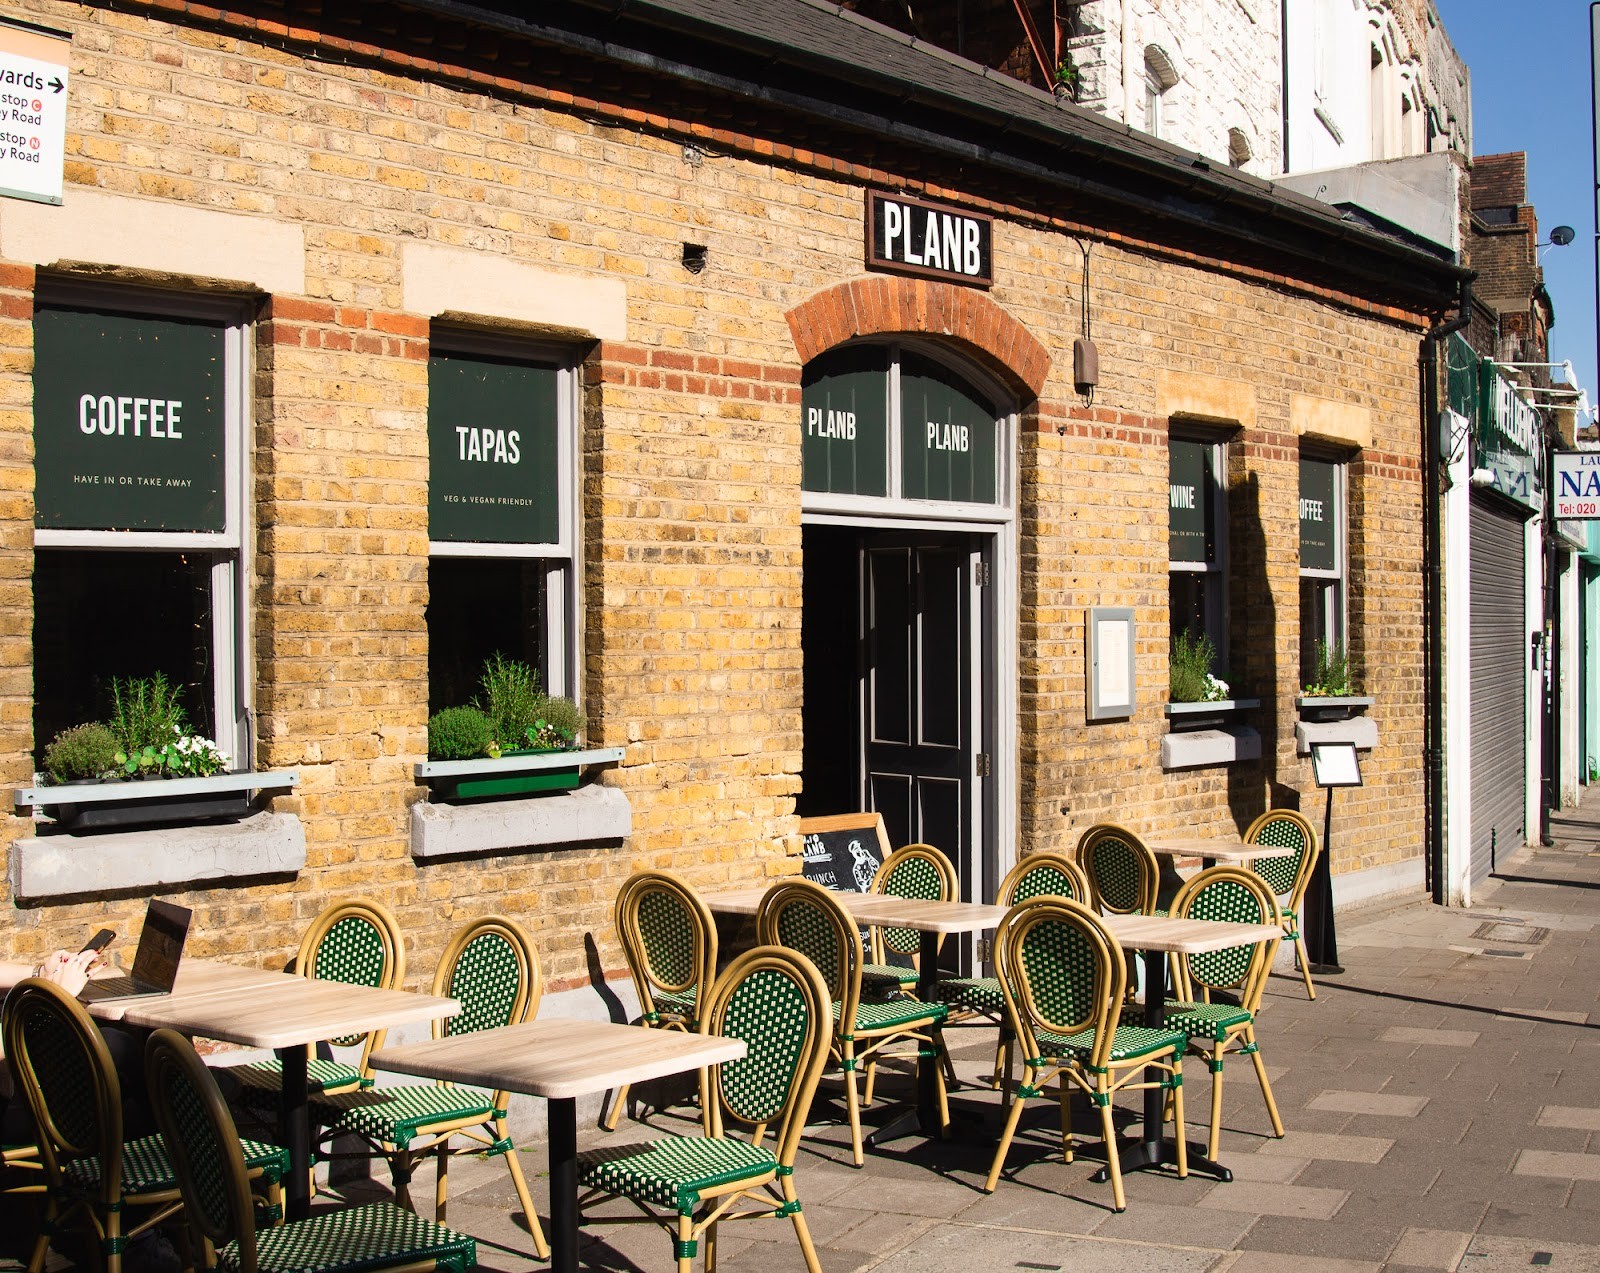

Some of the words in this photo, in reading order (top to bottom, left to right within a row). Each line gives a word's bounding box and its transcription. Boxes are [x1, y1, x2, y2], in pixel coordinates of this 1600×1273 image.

[1, 94, 28, 109] stop
[12, 109, 41, 125] Road
[0, 132, 26, 147] stop
[10, 147, 40, 163] Road
[884, 201, 981, 276] PLANB
[79, 393, 183, 439] COFFEE
[808, 407, 857, 440] PLANB
[927, 421, 969, 452] PLANB
[455, 426, 521, 464] TAPAS
[73, 475, 99, 484] HAVE
[104, 476, 115, 484] IN
[119, 476, 133, 485] OR
[137, 477, 162, 486] TAKE
[165, 478, 192, 487] AWAY
[469, 496, 495, 504] VEGAN
[497, 497, 533, 506] FRIENDLY
[1170, 484, 1195, 509] WINE
[1558, 503, 1575, 514] Tel:
[1576, 503, 1596, 514] 020
